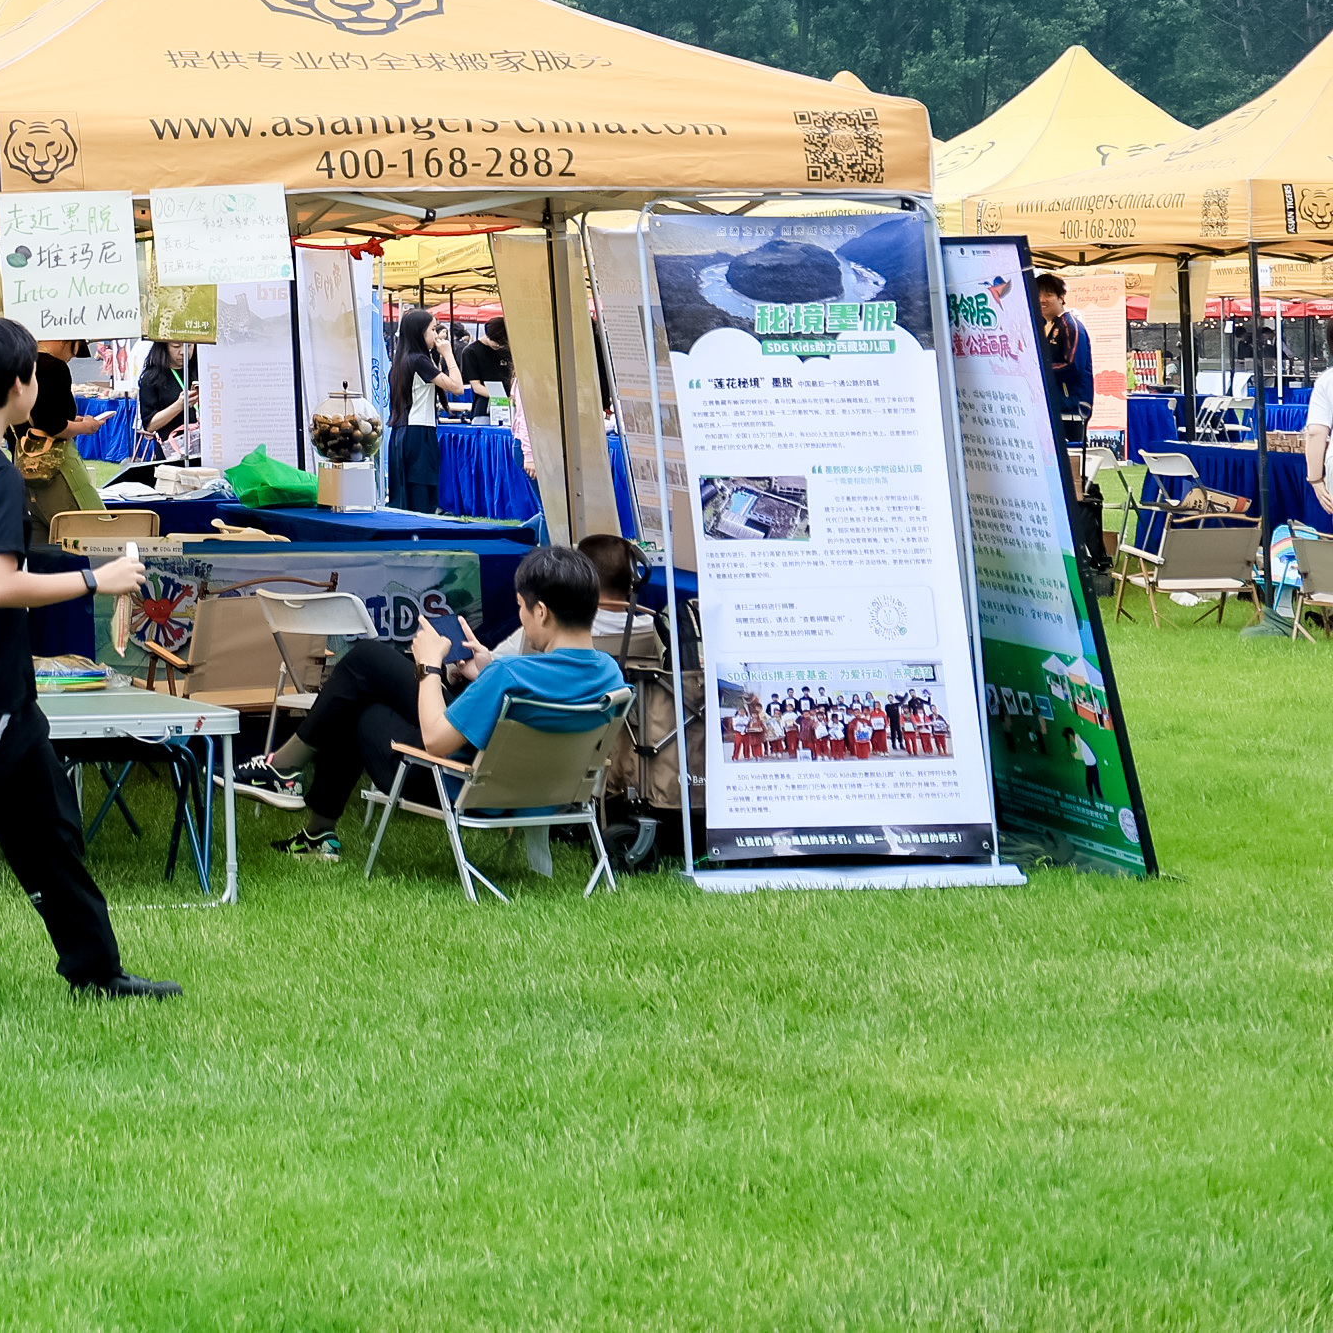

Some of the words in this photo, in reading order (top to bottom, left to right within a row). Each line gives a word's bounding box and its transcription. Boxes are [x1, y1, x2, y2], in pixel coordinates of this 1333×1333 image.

[316, 147, 576, 180] 400-168-2882
[1016, 190, 1186, 215] www.asiantigers-china.com
[1284, 184, 1294, 207] TIGERS
[4, 202, 121, 237] 走近墨脱
[716, 225, 860, 237] 点滴之爱，照亮成长之路
[1059, 218, 1137, 240] 400-168-2882
[1286, 208, 1298, 234] ASIAN
[37, 242, 122, 270] 堆玛尼
[12, 279, 59, 305] Into
[68, 276, 130, 298] Motuo
[40, 306, 87, 328] Build
[97, 303, 139, 322] Mani
[755, 301, 898, 335] 秘境墨脱
[767, 342, 790, 353] SDG
[791, 341, 891, 354] Kids助力西藏幼儿园
[772, 377, 794, 389] 墨脱
[798, 379, 881, 388] 中国最后一个通公路的县城
[371, 592, 453, 640] IDS
